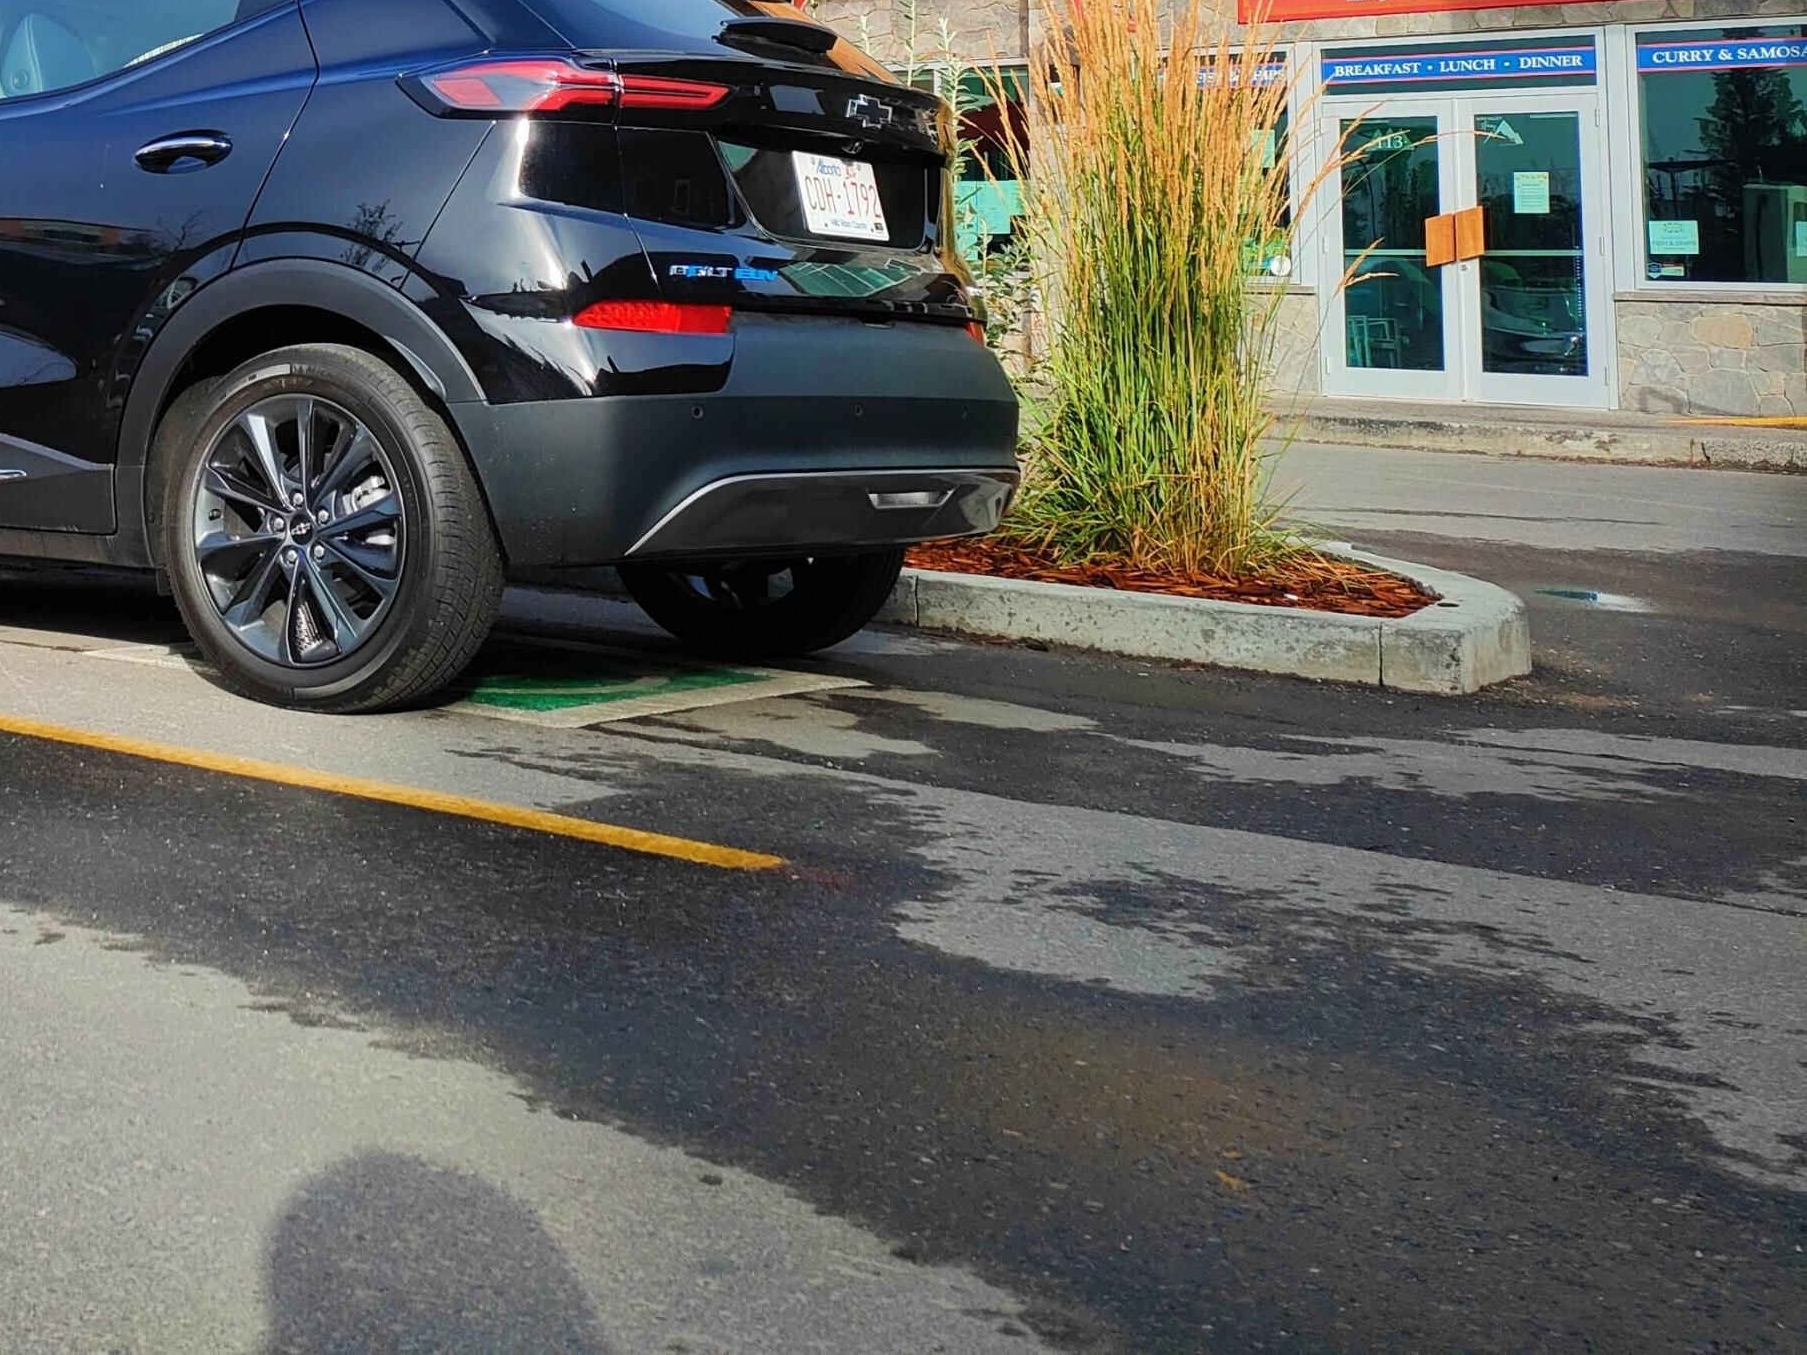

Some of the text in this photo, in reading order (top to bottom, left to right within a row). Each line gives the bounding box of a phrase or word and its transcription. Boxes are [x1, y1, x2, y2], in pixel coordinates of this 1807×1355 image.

[1652, 49, 1714, 63] CURRY
[1718, 48, 1733, 61] &
[1334, 55, 1582, 78] BREAKFAST LUNCH DINNER
